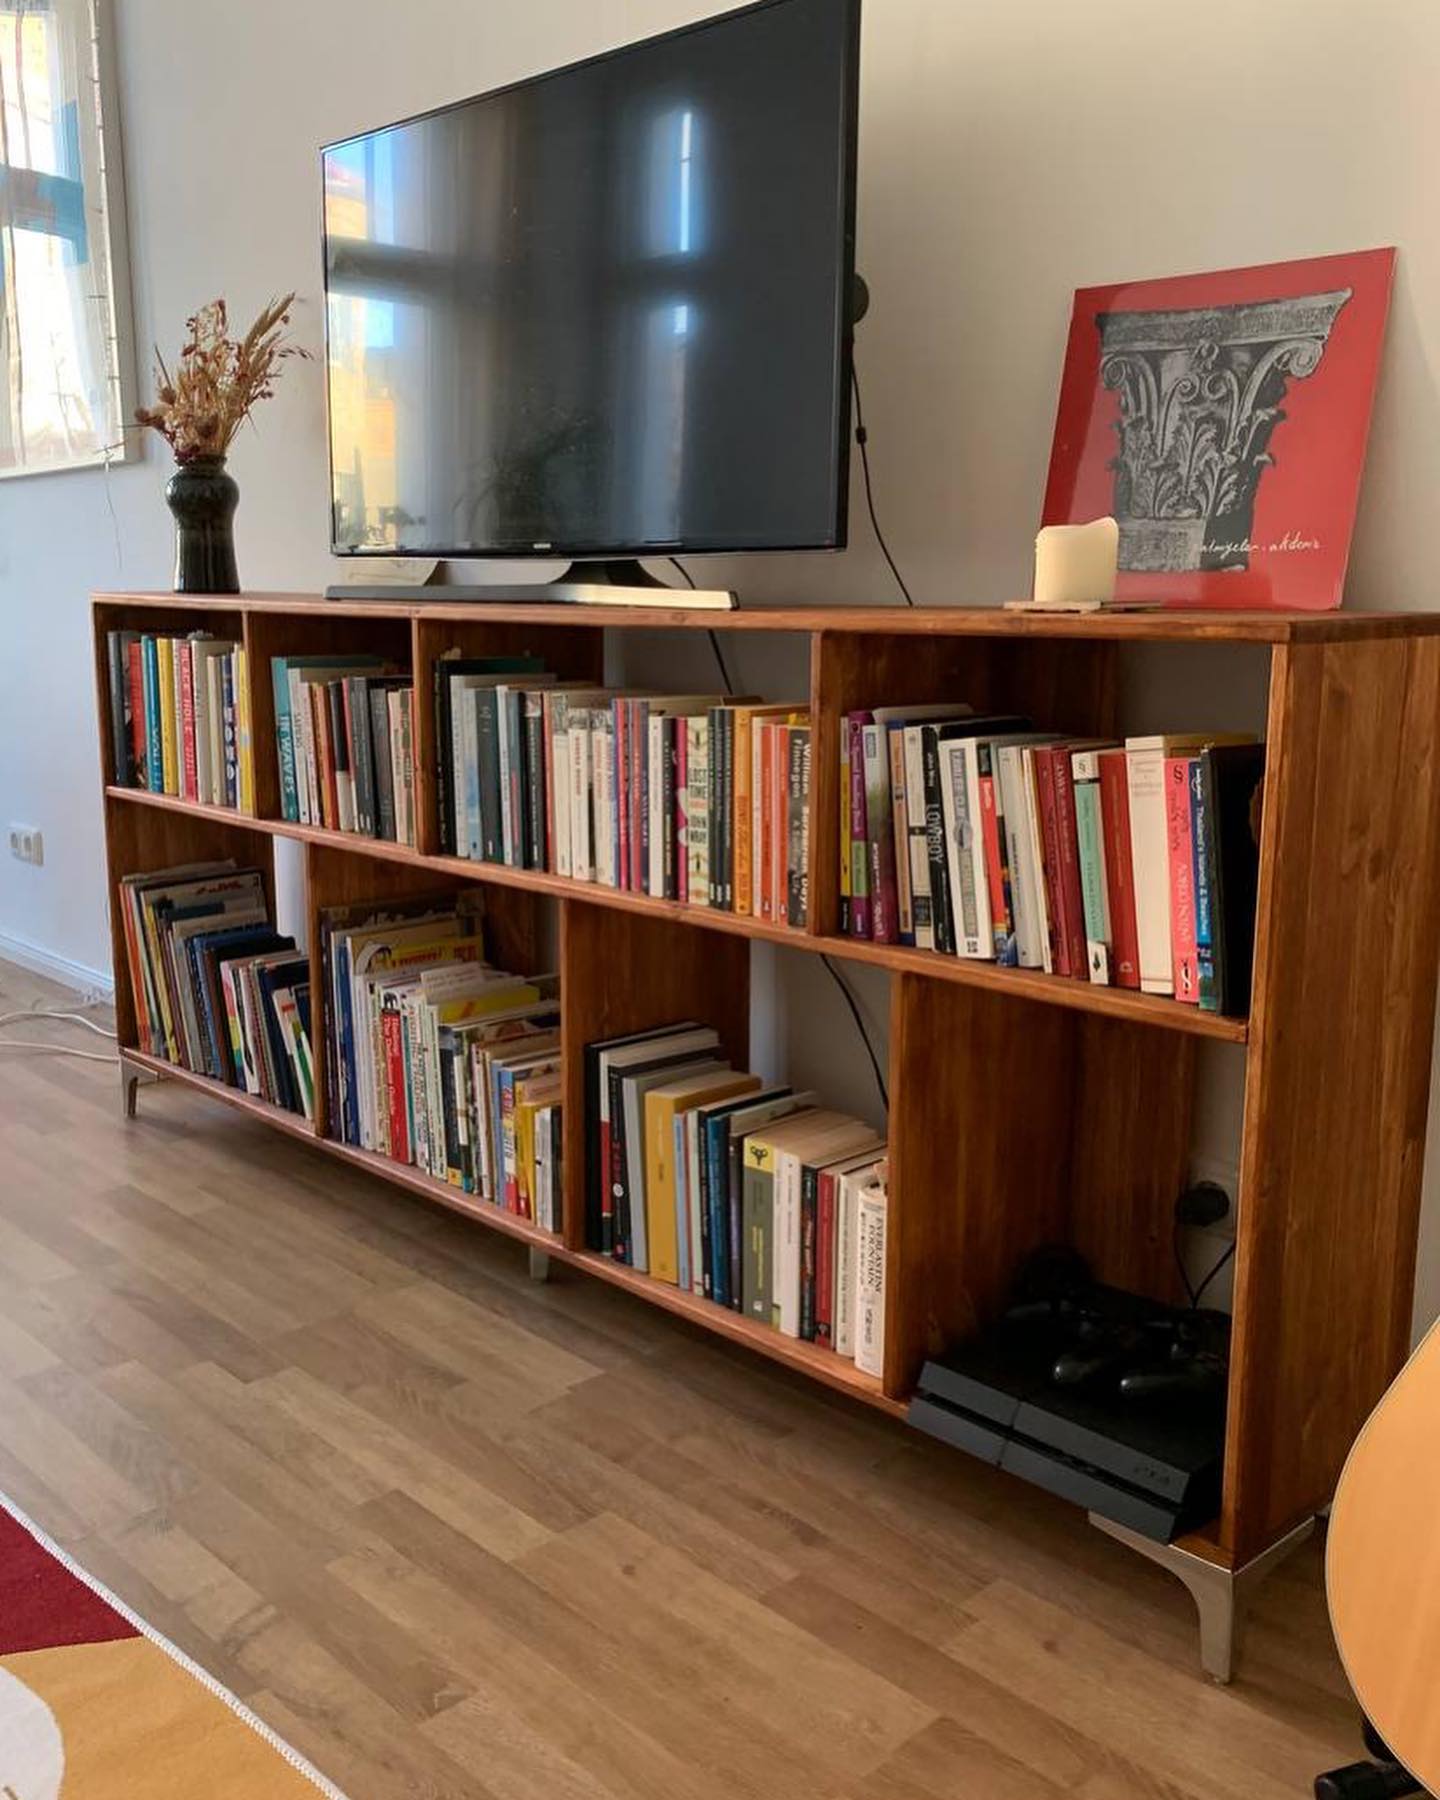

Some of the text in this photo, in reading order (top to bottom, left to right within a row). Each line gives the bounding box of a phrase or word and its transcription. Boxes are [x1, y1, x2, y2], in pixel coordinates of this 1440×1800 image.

[280, 736, 295, 794] WAVES
[802, 743, 812, 795] William
[925, 803, 944, 864] LOWBOY
